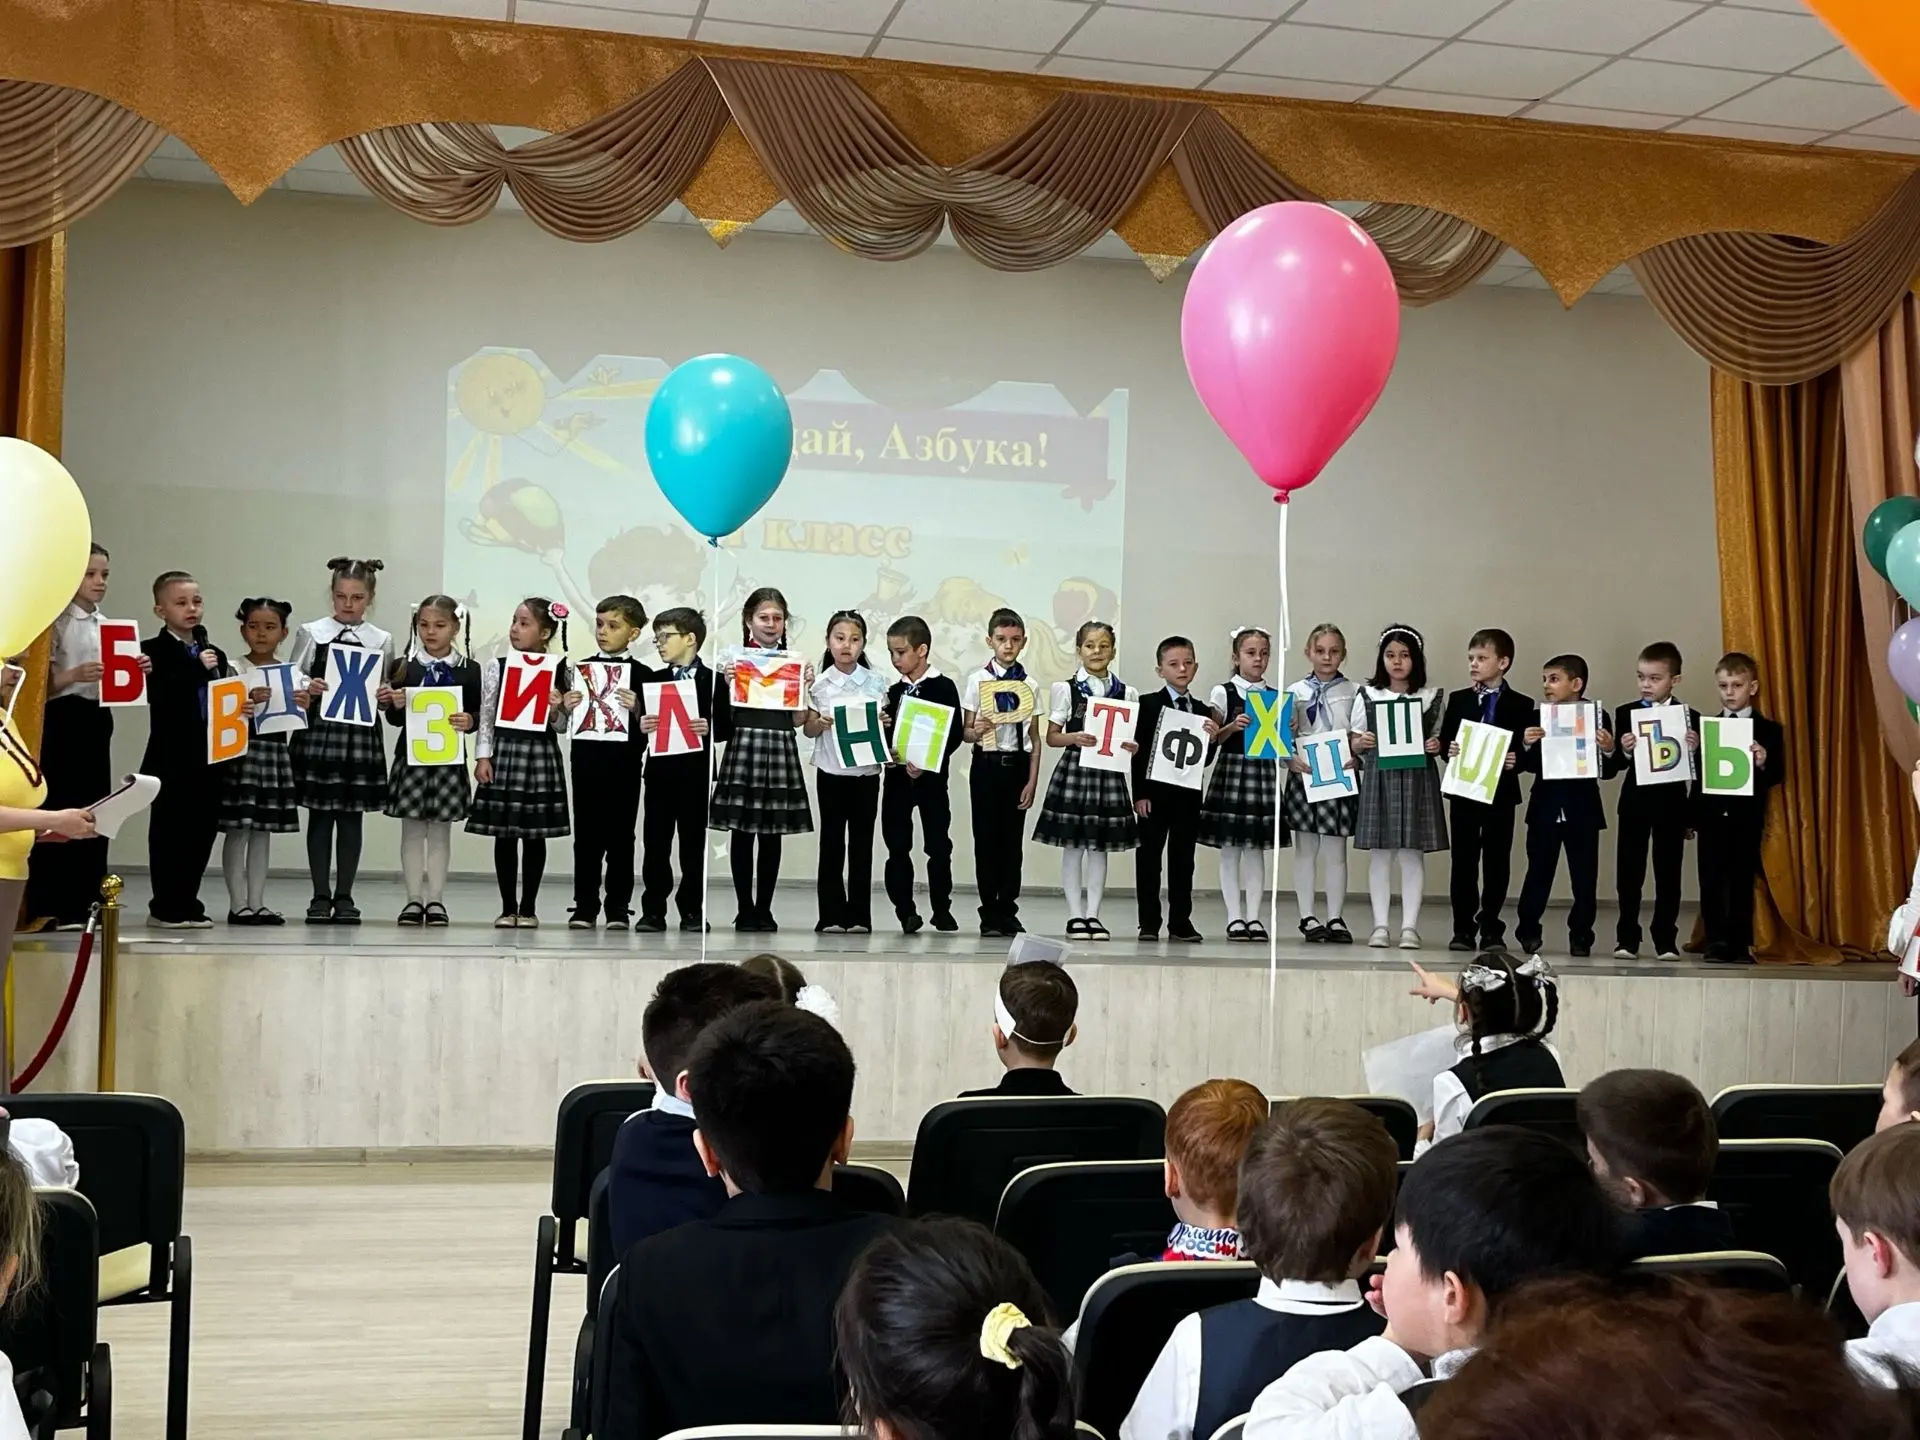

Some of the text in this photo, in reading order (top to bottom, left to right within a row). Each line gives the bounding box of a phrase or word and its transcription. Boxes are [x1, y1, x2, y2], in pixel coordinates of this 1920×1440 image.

[879, 421, 1049, 474] Азбука!
[762, 518, 913, 559] класс
[100, 625, 145, 702] Б
[325, 648, 382, 722] Ж
[500, 655, 553, 725] Й
[734, 659, 803, 708] М
[212, 680, 248, 761] В
[256, 663, 307, 734] Д
[654, 683, 701, 753] Л
[979, 680, 1034, 752] Р
[1092, 702, 1131, 757] Т
[1246, 692, 1291, 758] Х
[1375, 701, 1425, 757] Ш
[834, 701, 892, 768] Н
[899, 700, 950, 771] П
[1161, 727, 1203, 769] Ф
[1302, 739, 1352, 792] Ц
[1638, 720, 1682, 773] Ъ
